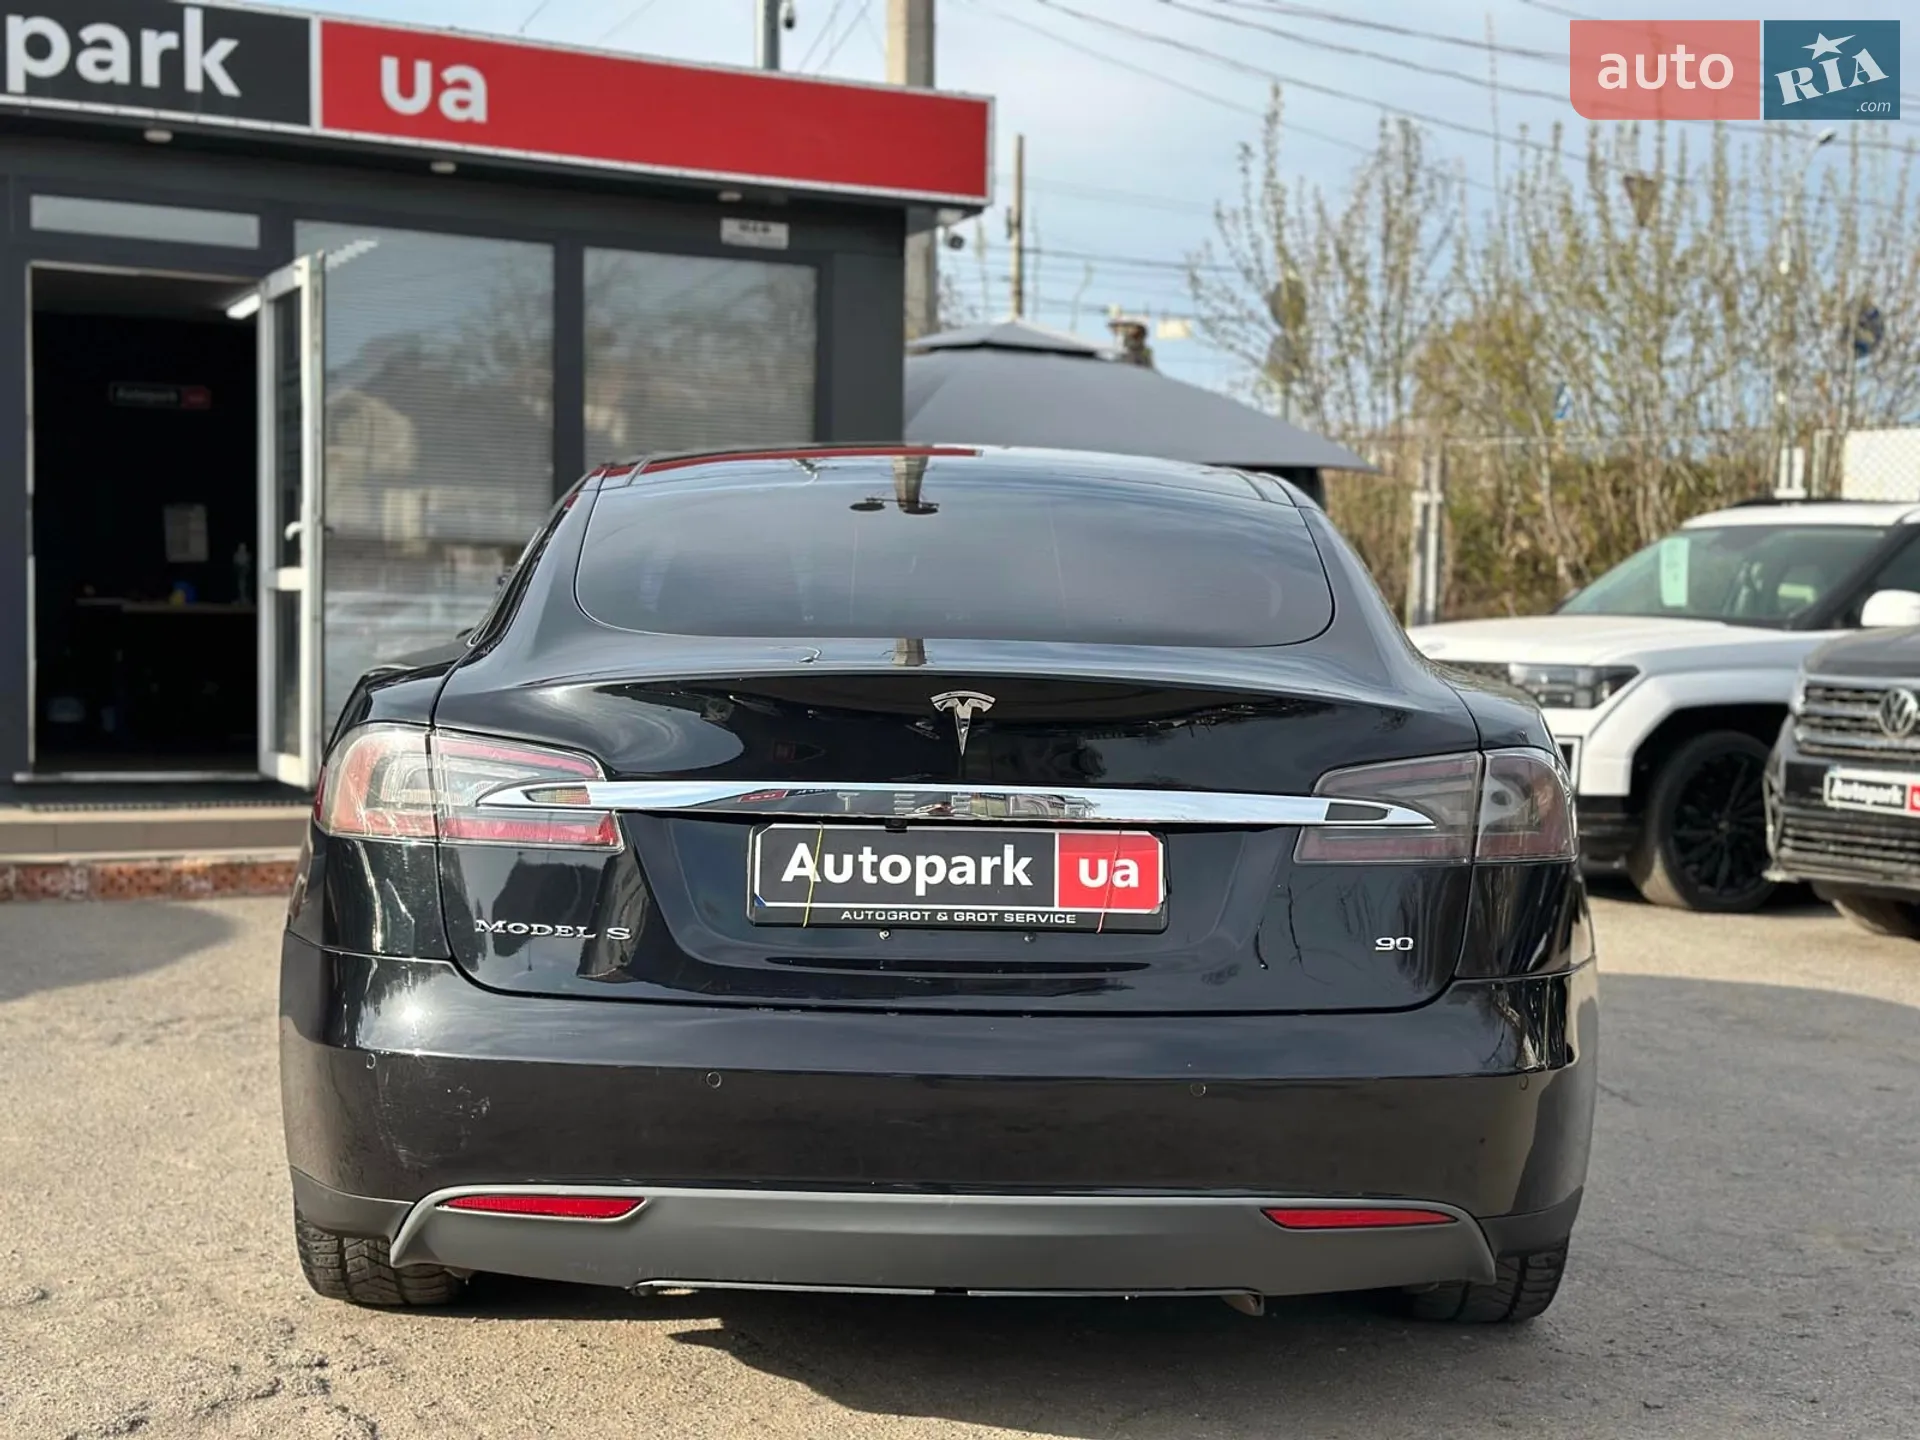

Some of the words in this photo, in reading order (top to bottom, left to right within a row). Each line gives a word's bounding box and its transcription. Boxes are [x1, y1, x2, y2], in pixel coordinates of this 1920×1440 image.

[6, 6, 242, 97] park
[381, 54, 488, 124] ua
[1831, 777, 1903, 806] Autopark
[781, 842, 1034, 897] Autopark
[1078, 856, 1140, 889] ua
[474, 919, 597, 939] MODEL
[606, 927, 632, 940] S
[840, 910, 932, 922] AUTOGROT
[936, 911, 949, 921] &
[953, 912, 999, 923] GROT
[1003, 913, 1077, 924] SERVICE
[1375, 937, 1414, 951] 90
